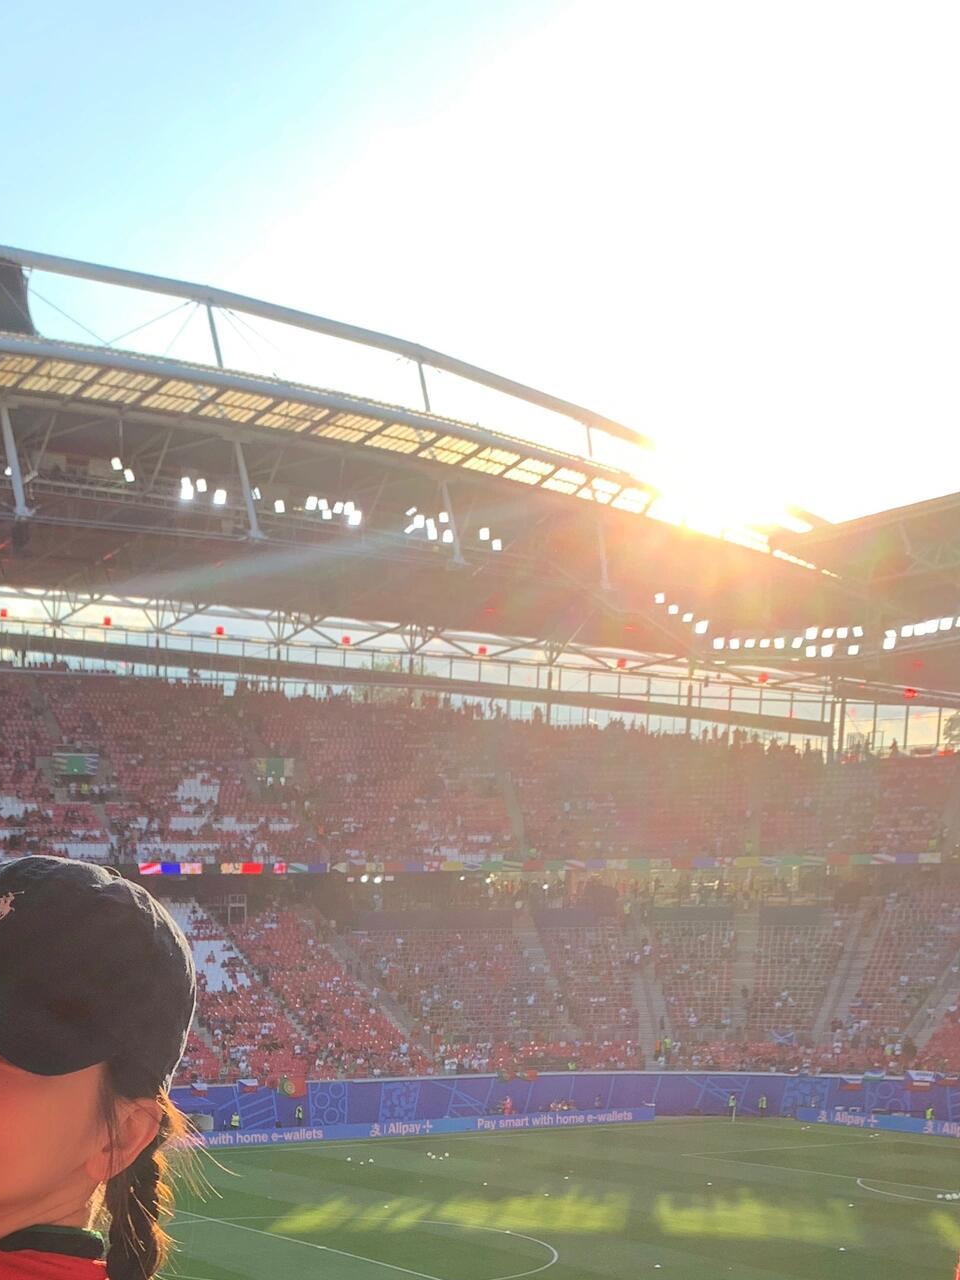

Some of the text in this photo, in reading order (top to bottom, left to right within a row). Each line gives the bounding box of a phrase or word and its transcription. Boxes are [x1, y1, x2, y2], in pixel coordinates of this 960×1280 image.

[477, 1110, 633, 1130] Pay smart with home e-wallets
[208, 1131, 234, 1146] with
[236, 1130, 268, 1144] home
[271, 1128, 324, 1142] e-wallets
